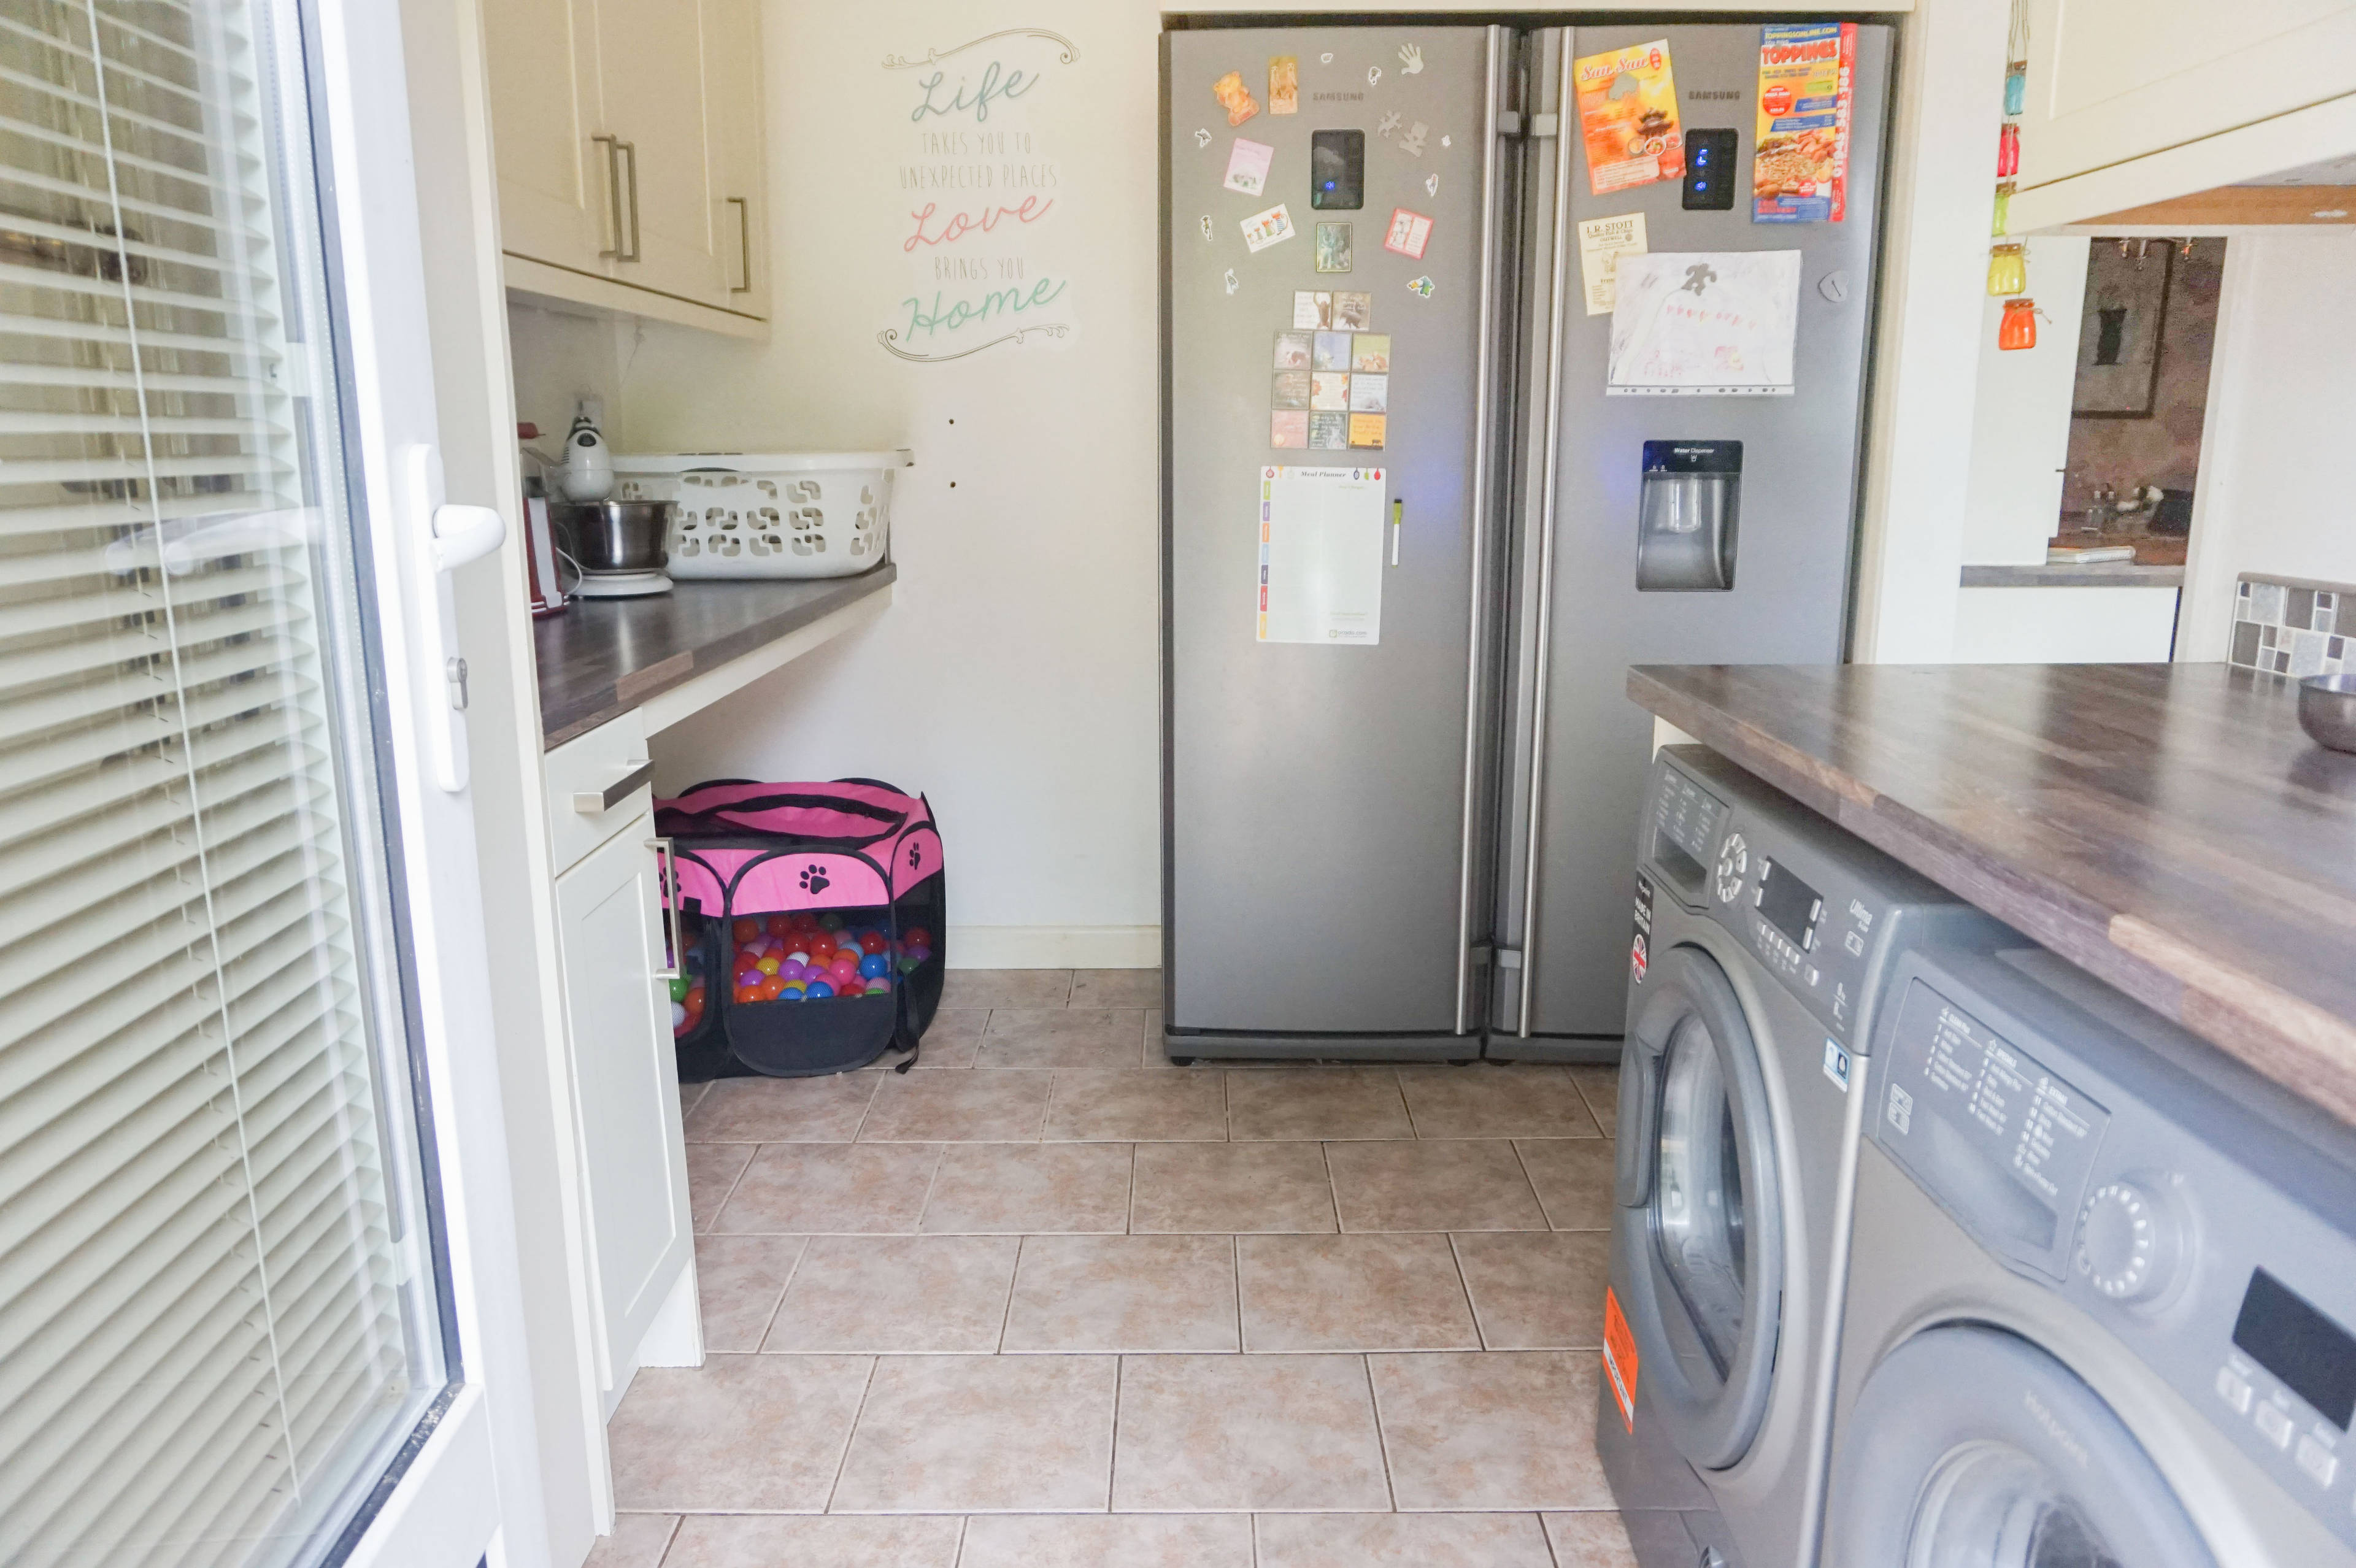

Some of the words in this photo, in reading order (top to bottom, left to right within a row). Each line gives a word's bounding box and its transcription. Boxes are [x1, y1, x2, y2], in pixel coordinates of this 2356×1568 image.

[1762, 40, 1837, 64] TOPPINGS
[912, 61, 1039, 122] Life
[1689, 91, 1740, 99] SAMSUNG
[922, 132, 968, 155] TAKES
[977, 132, 1004, 154] YOU
[1015, 132, 1031, 153] TO
[899, 165, 993, 188] UNEXPECTED
[1003, 164, 1057, 187] PLACES
[904, 195, 1053, 252] Love
[1606, 220, 1633, 231] STOTT
[934, 256, 987, 280] BRINGS
[998, 257, 1024, 279] YOU
[902, 277, 1066, 342] Home
[1635, 896, 1647, 916] MADE
[1634, 909, 1650, 935] BRITAIN
